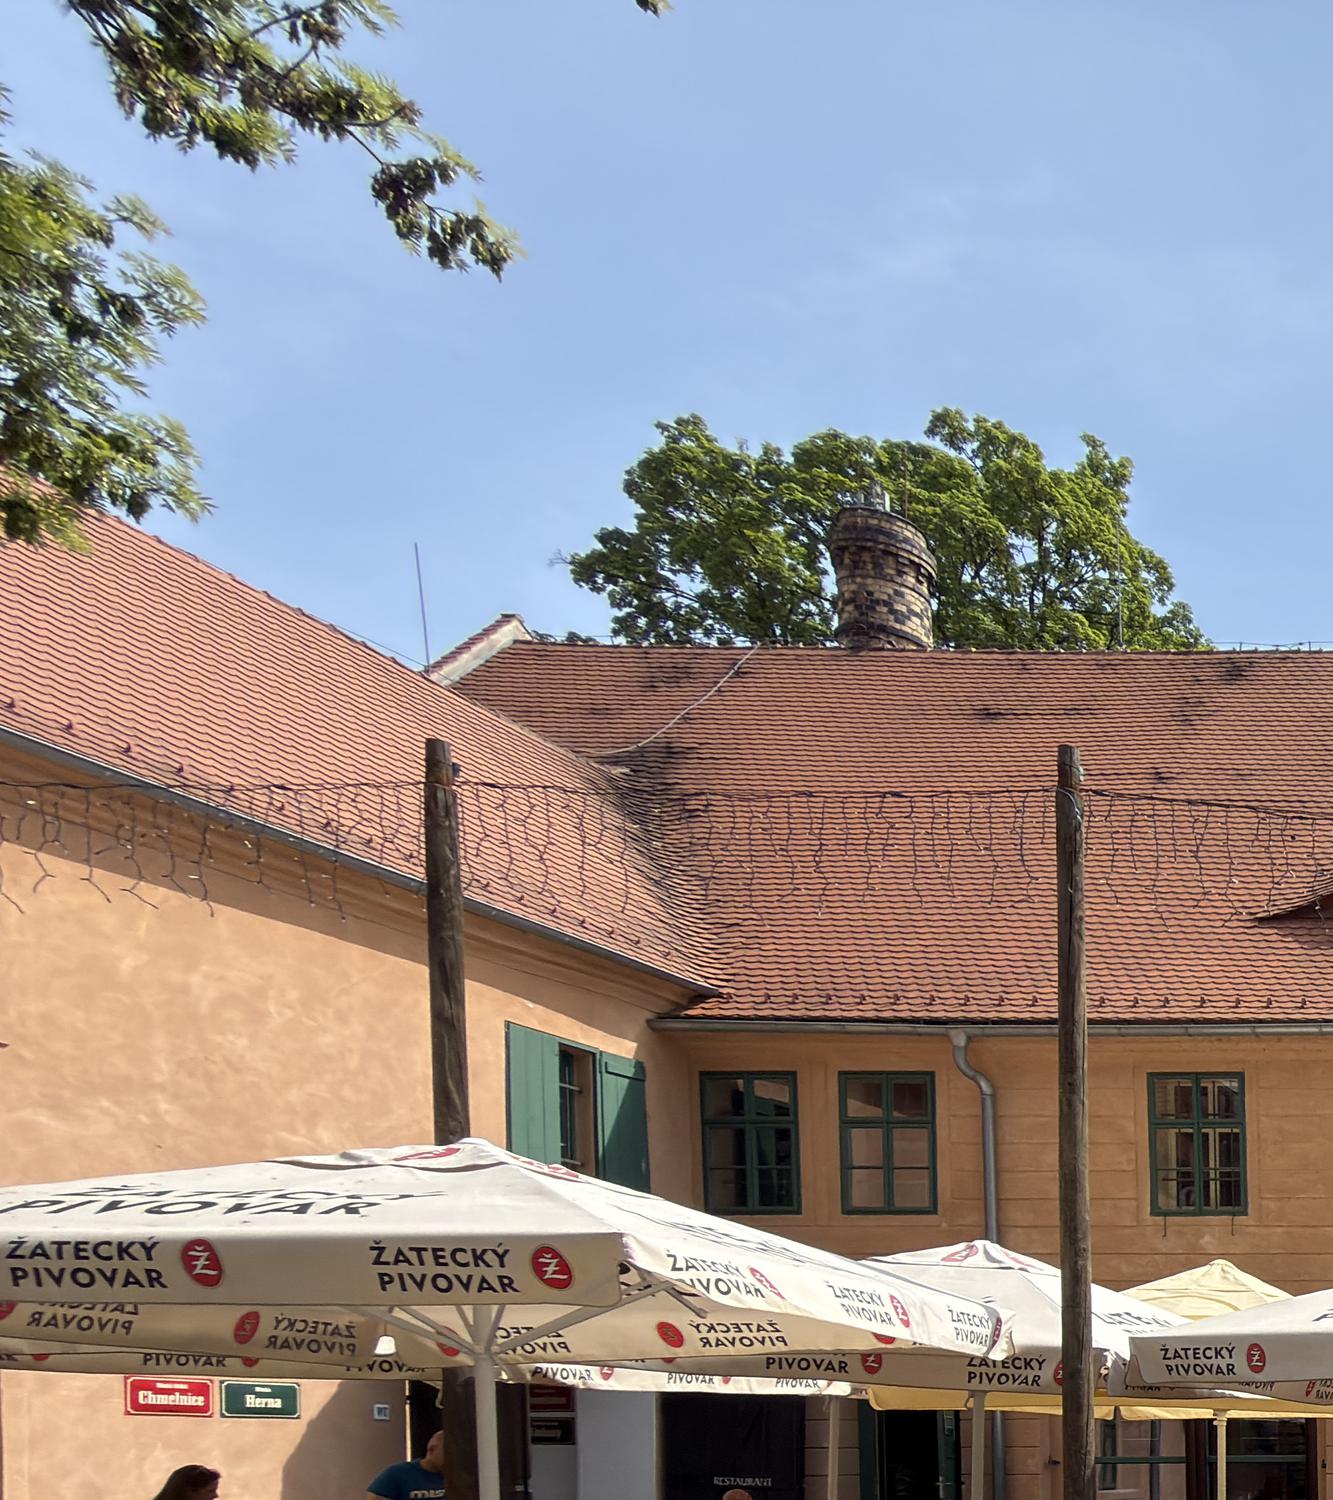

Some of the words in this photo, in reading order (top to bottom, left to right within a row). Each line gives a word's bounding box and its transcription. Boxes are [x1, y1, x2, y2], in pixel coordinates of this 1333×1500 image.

[5, 1236, 160, 1261] ŽATECKÝ
[369, 1240, 510, 1268] ŽATECKÝ
[10, 1267, 168, 1288] PIVOVAR
[378, 1273, 521, 1293] PIVOVAR
[826, 1281, 885, 1305] ŽATECKÝ
[841, 1304, 895, 1327] PIVOVAR
[947, 1306, 990, 1327] ŽATECKÝ
[954, 1327, 989, 1346] PIVOVAR
[1160, 1343, 1236, 1361] ŽATECKÝ
[766, 1357, 849, 1374] PIVOVAR
[1166, 1363, 1237, 1376] PIVOVAR
[967, 1372, 1040, 1387] PIVOVAR
[139, 1391, 204, 1406] Chmelnice
[245, 1395, 282, 1408] Herna
